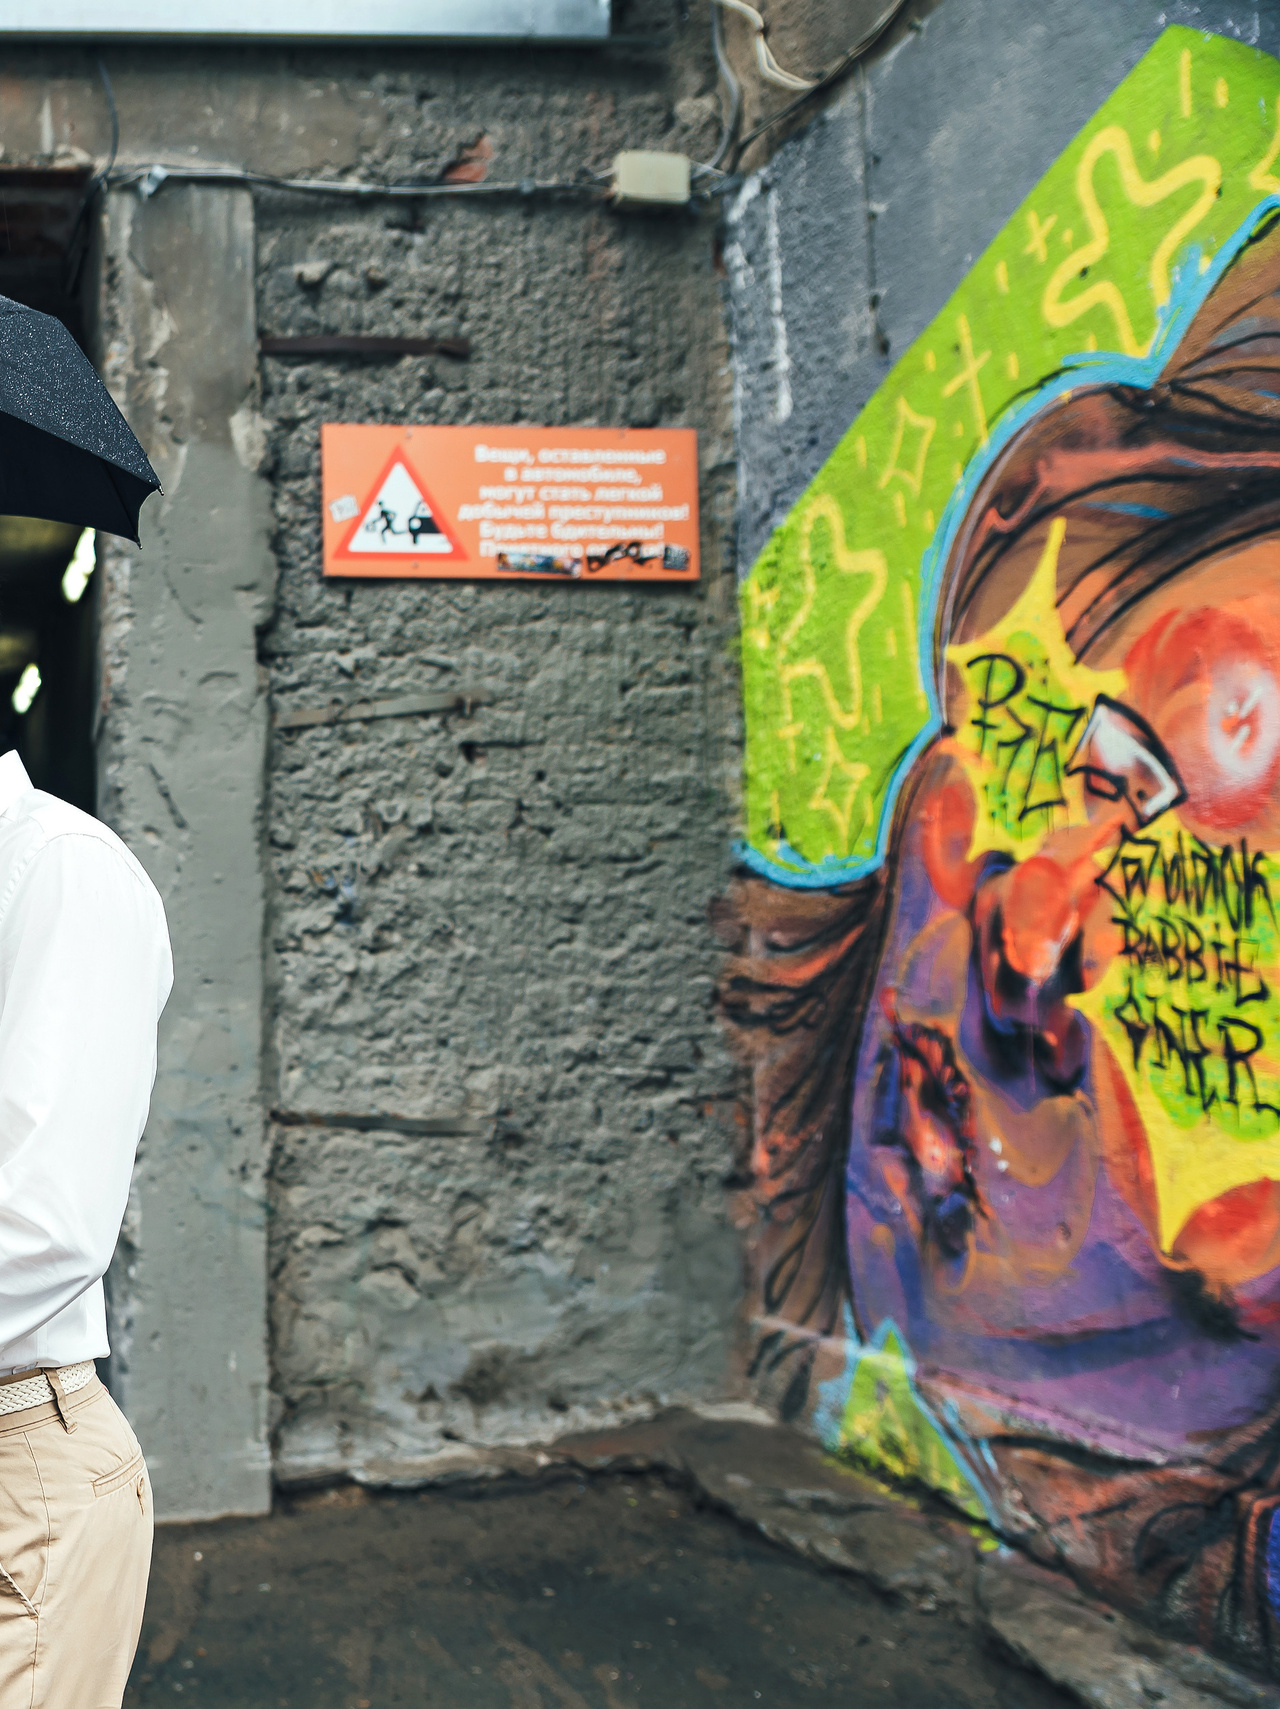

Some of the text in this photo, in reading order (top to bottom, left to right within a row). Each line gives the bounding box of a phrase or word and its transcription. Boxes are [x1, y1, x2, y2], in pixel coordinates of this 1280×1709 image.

[475, 444, 665, 465] Вещи, оставленные
[504, 464, 642, 485] в автомобиле,
[479, 484, 662, 504] могут стать легкой
[458, 501, 689, 523] добычей преступников!
[480, 521, 664, 541] Будьте бдительны!
